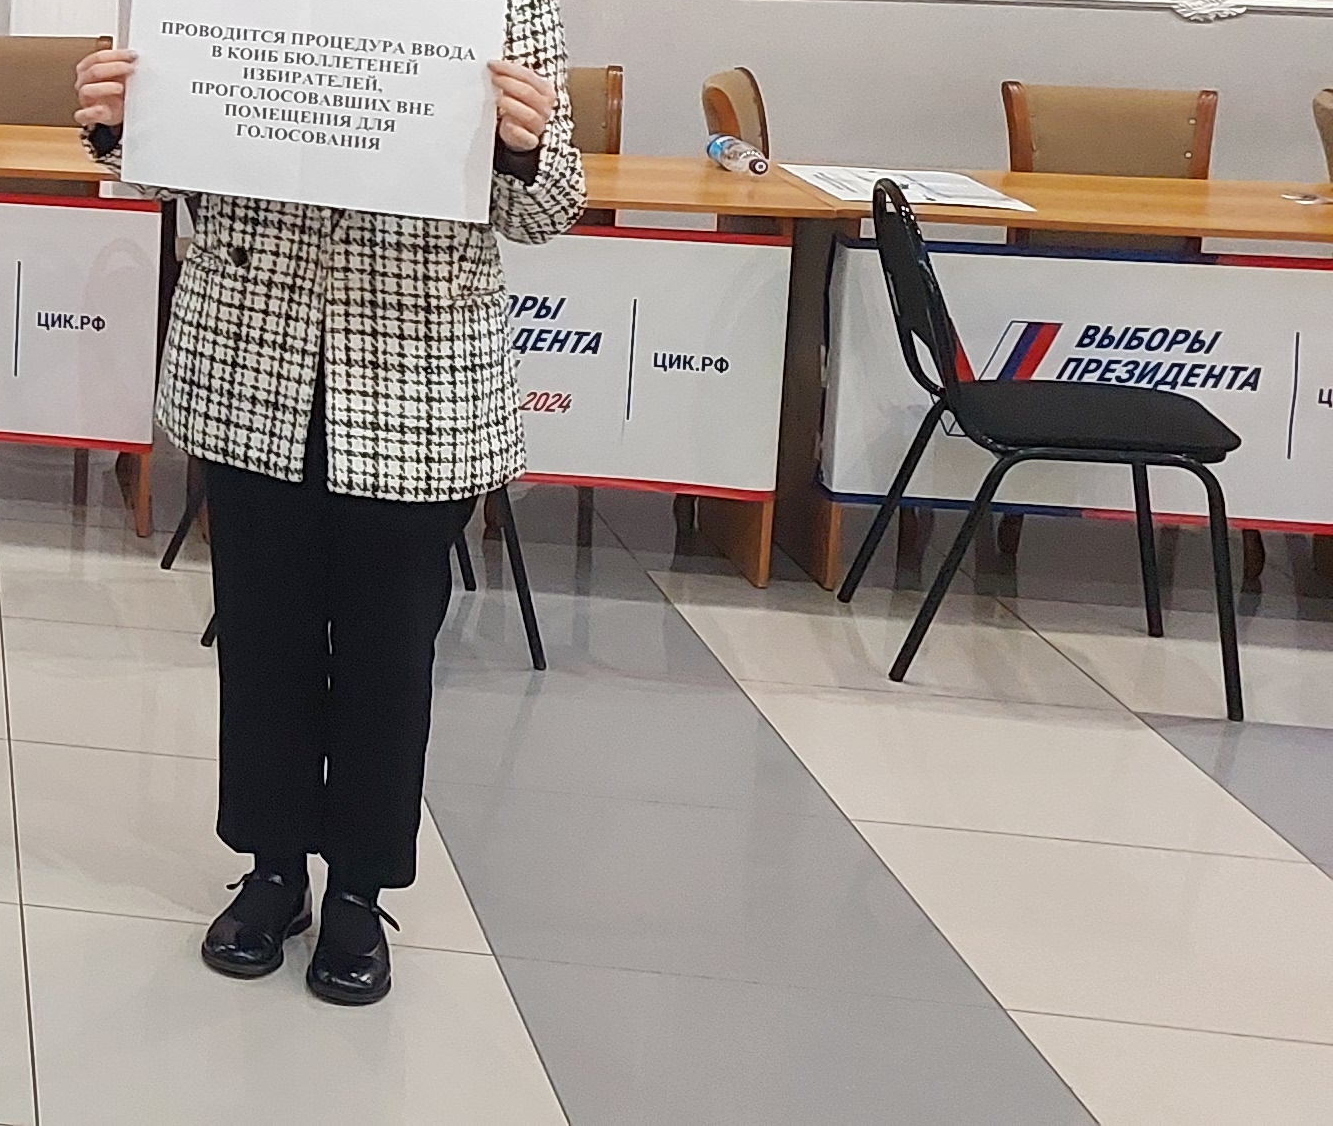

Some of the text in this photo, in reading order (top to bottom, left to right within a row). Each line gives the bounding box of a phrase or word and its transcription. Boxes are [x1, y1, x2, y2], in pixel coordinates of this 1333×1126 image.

[161, 20, 476, 62] ПРОВОДИТСЯ ПРОЦЕДУРА ВВОДА
[211, 45, 419, 76] В КОИБ БЮЛЛЕТЕНЕЙ
[243, 67, 383, 93] ИЗБИРАТЕЛЕЙ,
[191, 81, 435, 117] ПРОГОЛОСОВАВШИХ ВНЕ
[224, 103, 396, 134] ПОМЕЩЕНИЯ ДЛЯ
[236, 124, 381, 152] ГОЛОСОВАНИЯ
[508, 294, 567, 320] ОРЫ
[37, 311, 106, 332] ЦИК.РФ
[511, 328, 603, 355] ДЕНТА
[1076, 325, 1222, 355] ВЫБОРЫ
[653, 352, 730, 374] ЦИК.РФ
[1056, 358, 1262, 392] ПРЕЗИДЕНТА
[518, 392, 572, 414] 2024
